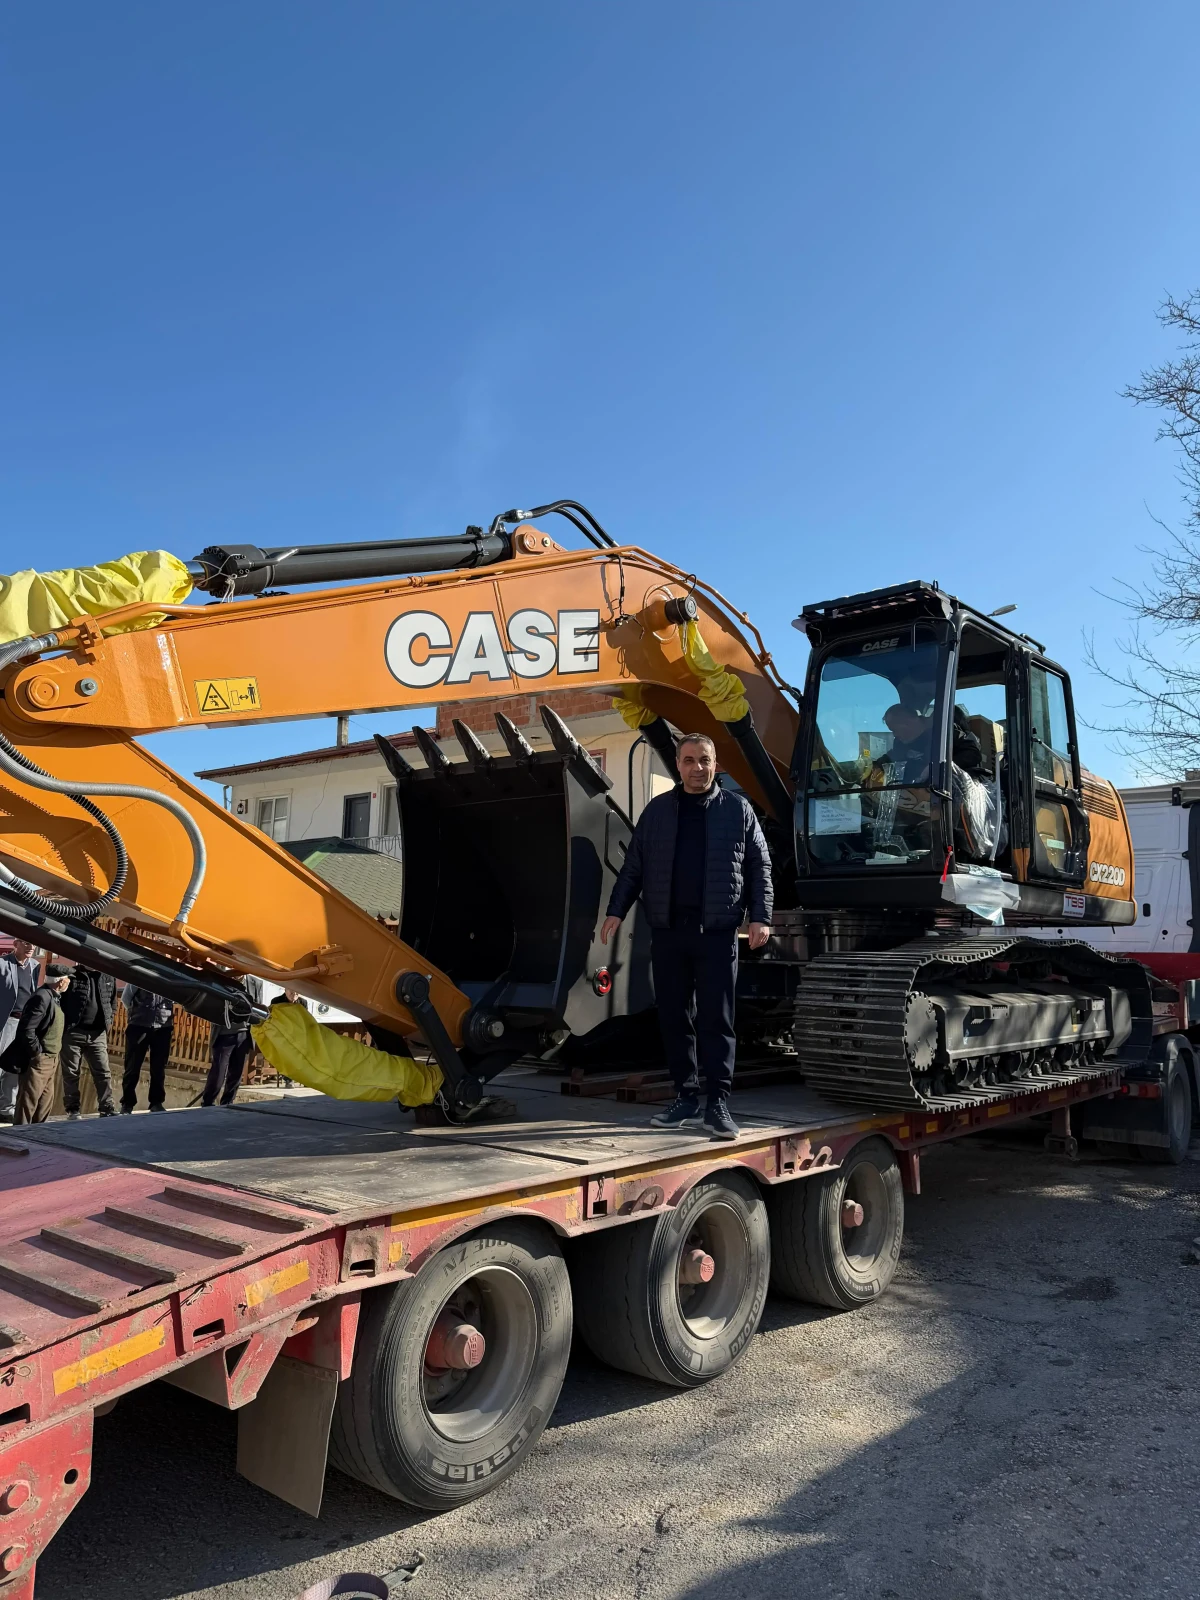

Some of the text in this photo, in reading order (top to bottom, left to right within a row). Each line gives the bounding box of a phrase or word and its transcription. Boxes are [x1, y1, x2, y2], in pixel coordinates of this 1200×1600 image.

[384, 608, 600, 689] CASE
[862, 638, 899, 652] CASE
[1089, 861, 1125, 887] CX220D
[444, 1247, 469, 1278] NZ
[430, 1427, 530, 1482] Petlas
